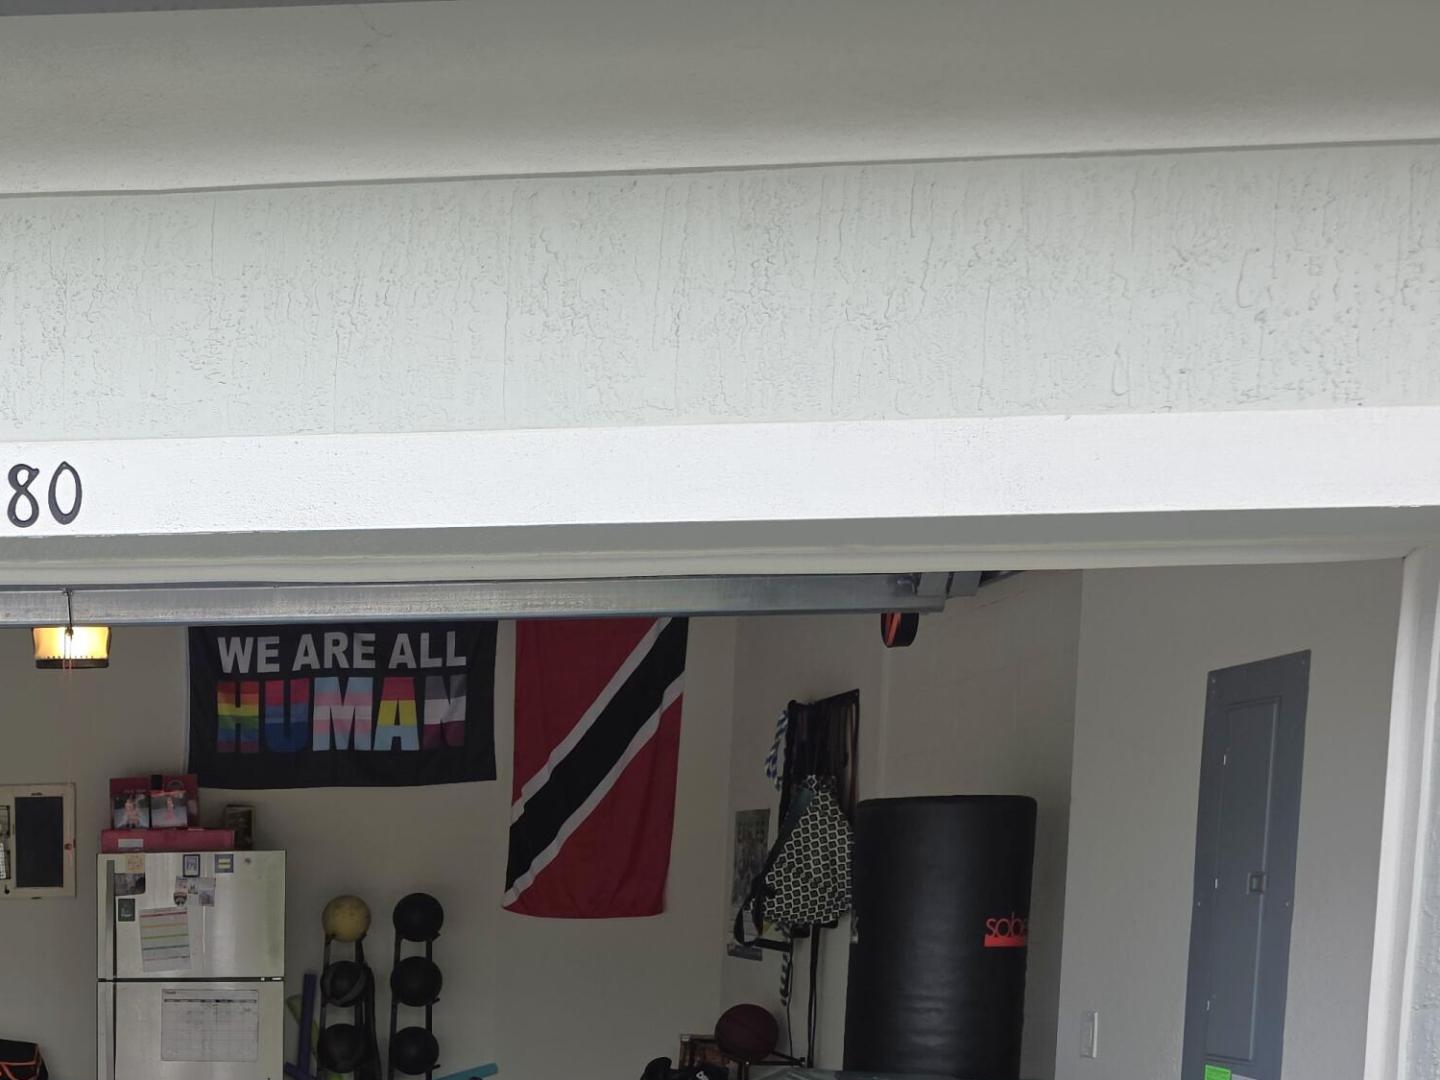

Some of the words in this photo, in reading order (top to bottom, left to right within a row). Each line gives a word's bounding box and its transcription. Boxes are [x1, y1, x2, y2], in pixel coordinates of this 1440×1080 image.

[217, 636, 280, 674] WE
[292, 631, 376, 671] ARE
[388, 631, 467, 669] ALL
[216, 674, 467, 753] HUMAN
